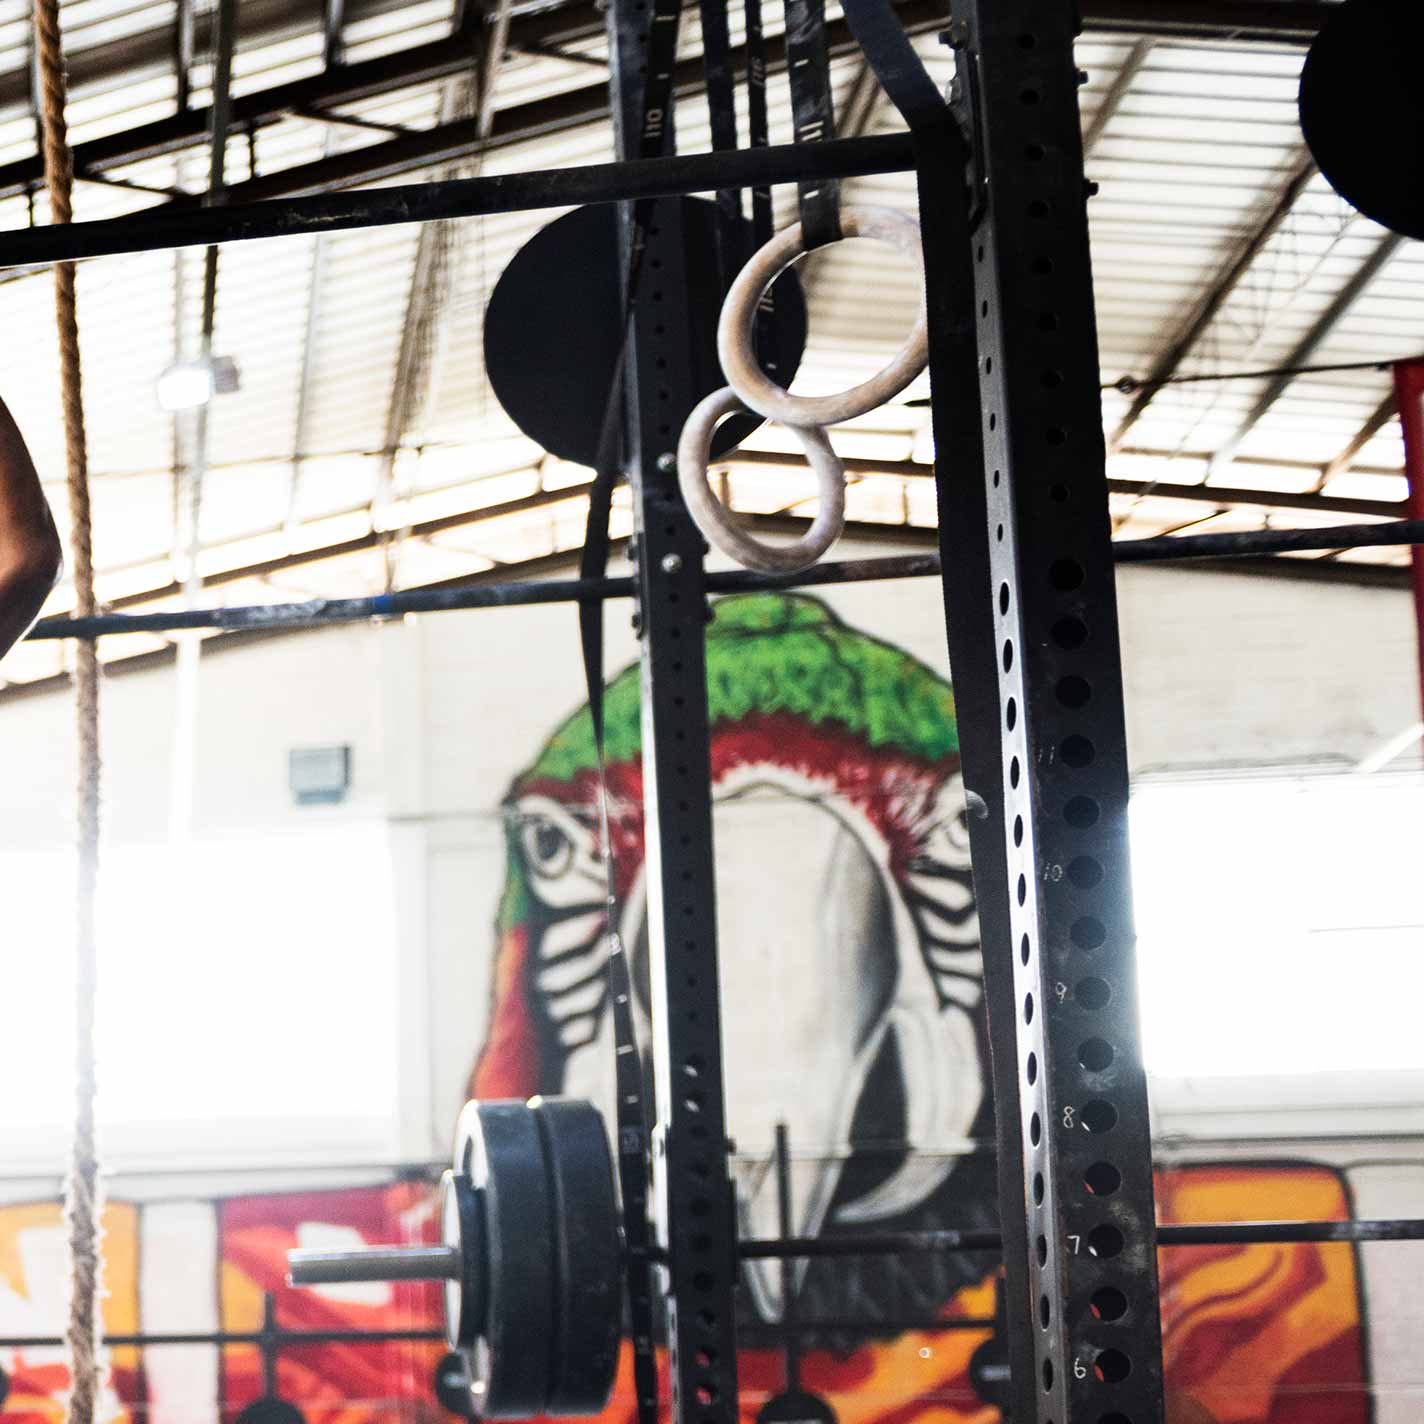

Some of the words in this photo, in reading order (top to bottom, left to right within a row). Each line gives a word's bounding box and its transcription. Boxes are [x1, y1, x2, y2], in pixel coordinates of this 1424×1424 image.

[1063, 1106, 1074, 1128] 8
[1067, 1235, 1080, 1255] 7
[1074, 1358, 1086, 1378] 6
